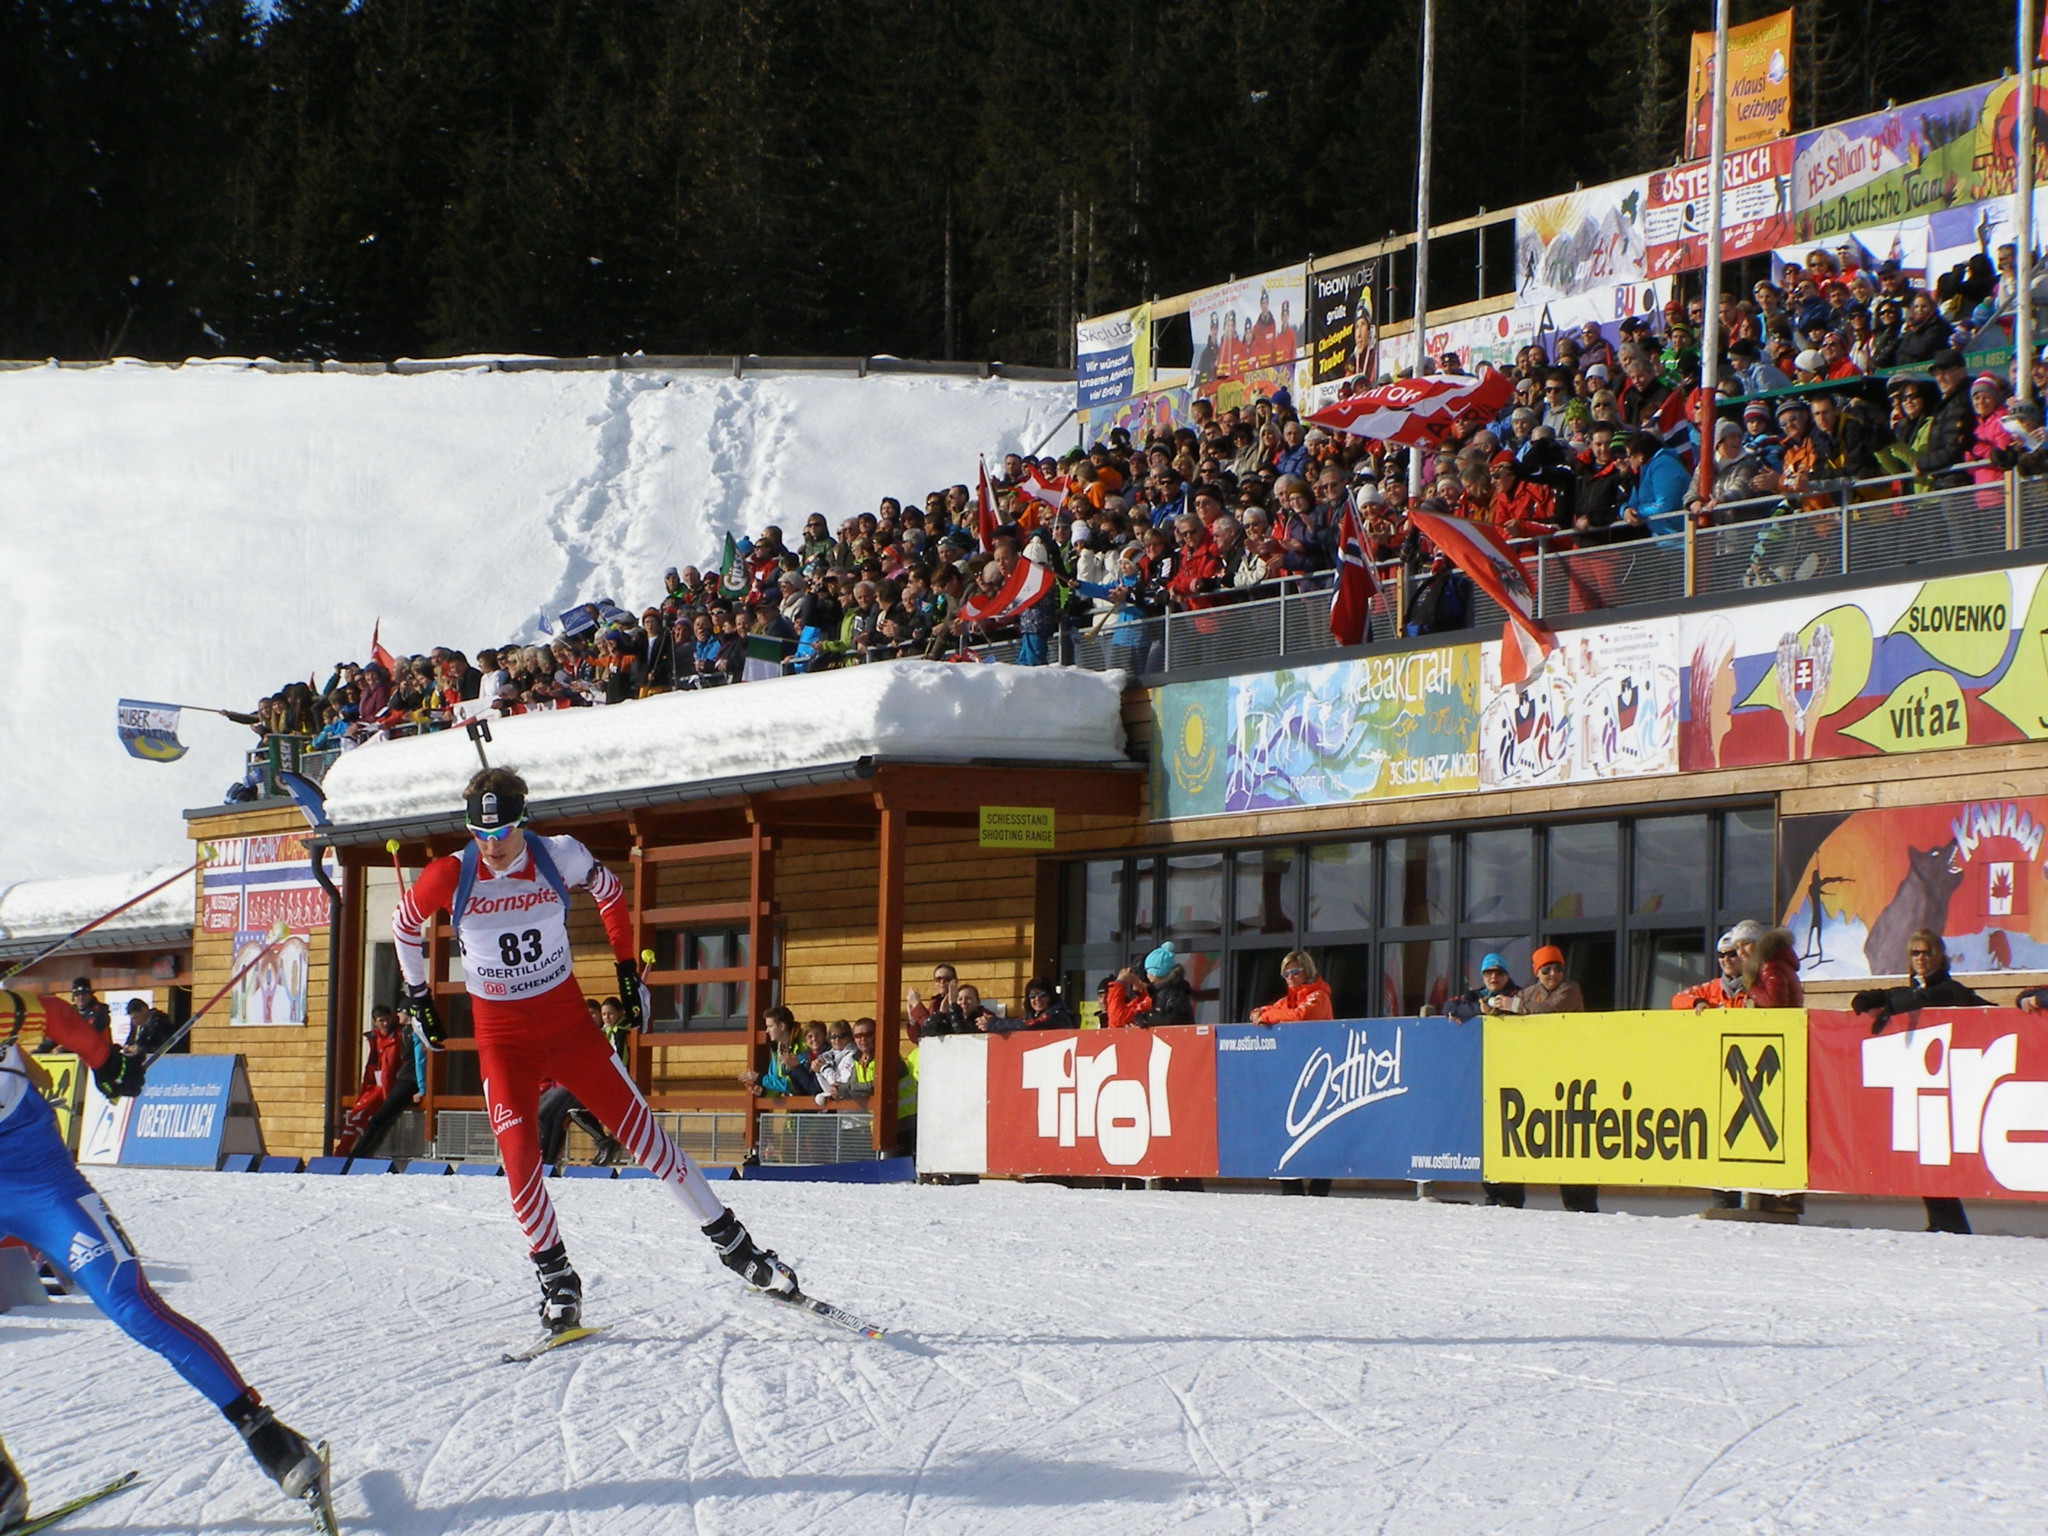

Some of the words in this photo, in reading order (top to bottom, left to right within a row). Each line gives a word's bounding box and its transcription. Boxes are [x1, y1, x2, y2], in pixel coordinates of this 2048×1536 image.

[1731, 73, 1766, 97] Klausi
[1737, 96, 1787, 121] Leitinger
[1662, 146, 1771, 202] ÖSTEREICH
[1813, 200, 1835, 236] das
[1838, 181, 1900, 231] Deutsche
[1326, 304, 1347, 326] grüßt
[1318, 323, 1354, 353] Christopher
[1909, 604, 2006, 632] SLOVENKO
[987, 813, 1048, 826] SCHIESSSTAND
[1952, 802, 2045, 862] KANADA
[982, 829, 1023, 841] SHOOTING
[1025, 830, 1053, 842] RANGE
[463, 887, 558, 917] Kornspitz
[477, 946, 564, 978] OBERTILLIACH
[498, 928, 543, 967] 83
[485, 983, 505, 995] DB
[510, 964, 567, 994] SCHENKER
[1219, 1035, 1278, 1051] www.osttirol.com
[1285, 1027, 1404, 1138] Osttirol
[1022, 1033, 1173, 1166] Tirol
[1861, 1022, 2048, 1192] Tiro
[136, 1103, 217, 1138] OBERTILLIACH
[1500, 1079, 1709, 1160] Raiffeisen
[1411, 1152, 1481, 1170] www.osttirol.com
